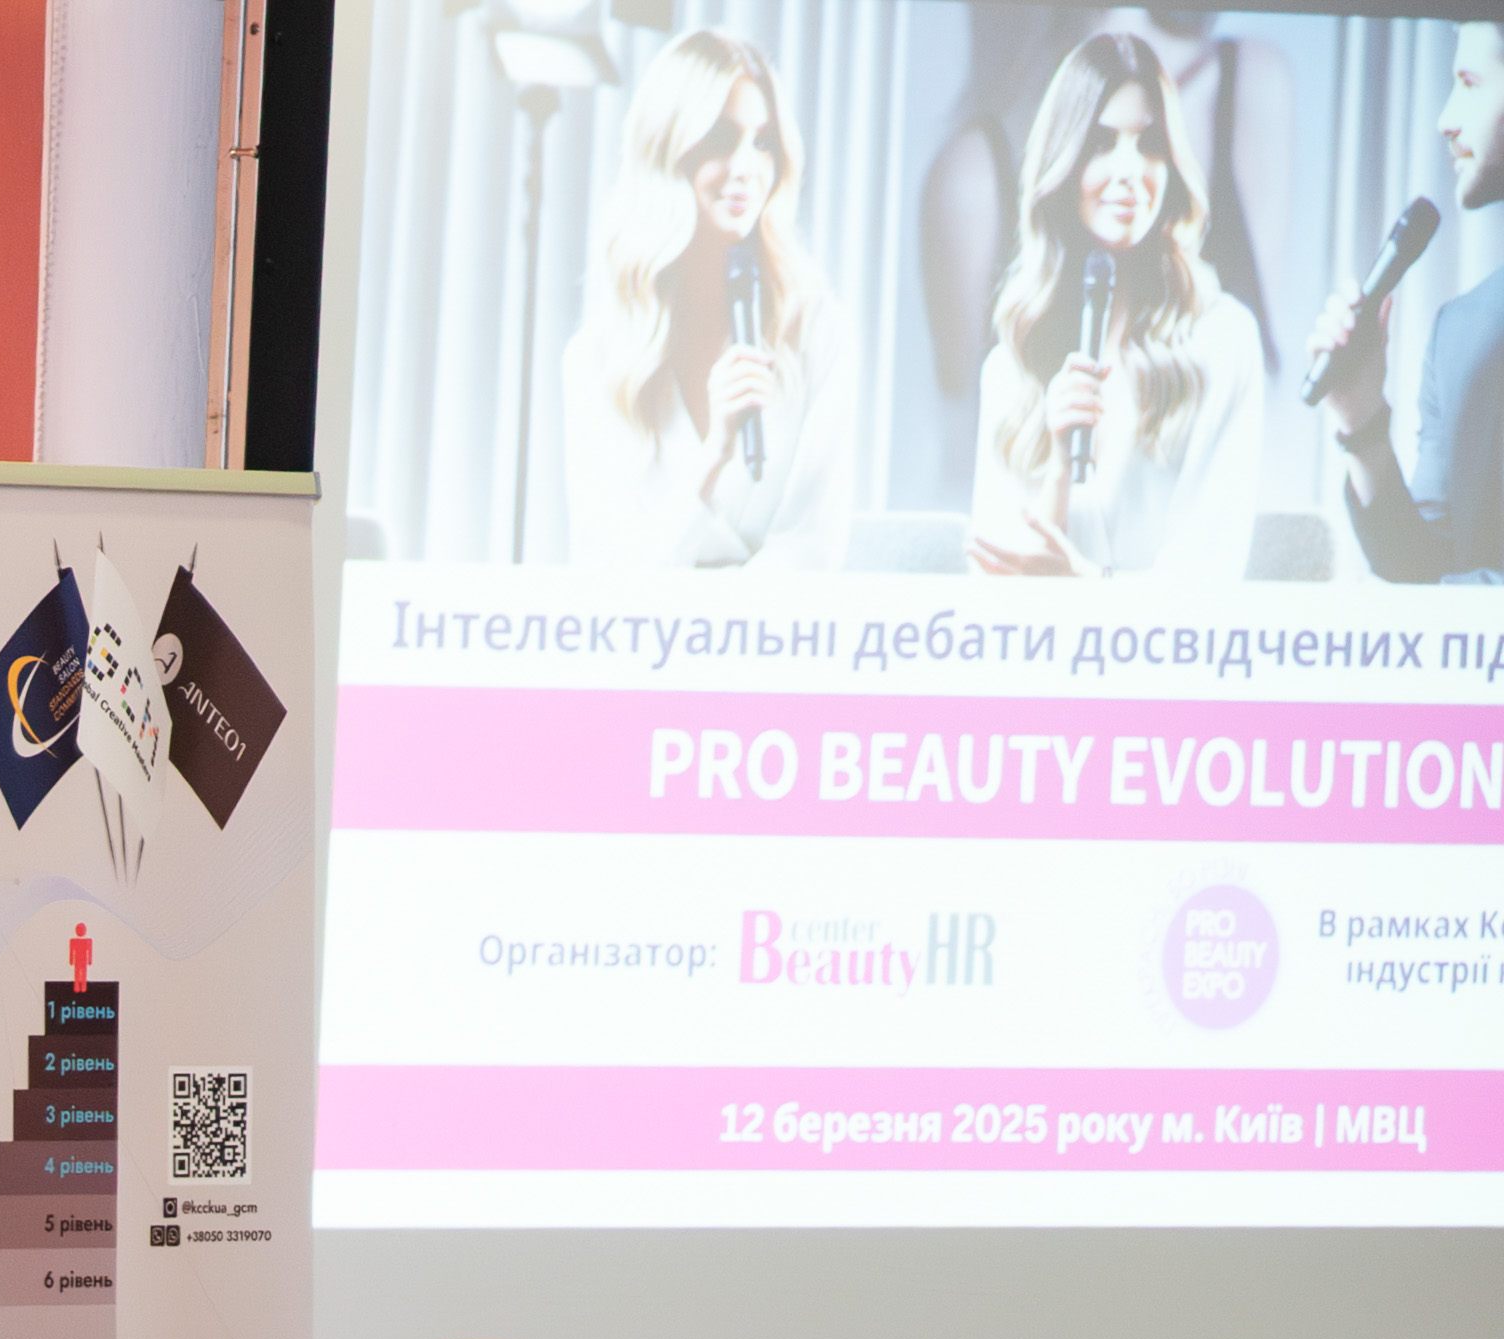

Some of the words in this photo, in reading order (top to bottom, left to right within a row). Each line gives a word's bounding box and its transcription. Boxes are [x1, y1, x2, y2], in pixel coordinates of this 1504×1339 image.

[391, 601, 838, 669] Інтелектуальні
[854, 609, 1057, 671] дебати
[1072, 623, 1424, 679] досвідчених
[649, 729, 798, 801] PRO
[819, 732, 1093, 804] BEAUTY
[1110, 735, 1503, 811] EVOLUTION
[1184, 909, 1236, 938] PRO
[1319, 909, 1336, 938] В
[1348, 914, 1469, 947] рамках
[479, 935, 718, 977] Організатор:
[1183, 940, 1268, 969] BEAUTY
[1348, 954, 1491, 993] індустрії
[48, 1002, 55, 1019] 1
[61, 1001, 115, 1024] рівень
[45, 1053, 56, 1071] 2
[61, 1053, 115, 1076] рівень
[45, 1105, 55, 1123] 3
[60, 1105, 114, 1128] рівень
[719, 1104, 764, 1143] 12
[773, 1102, 941, 1154] березня
[951, 1104, 1047, 1143] 2025
[1057, 1110, 1152, 1154] року
[1161, 1110, 1204, 1143] м.
[1215, 1104, 1304, 1144] Київ
[1336, 1104, 1427, 1153] МВЦ
[44, 1157, 55, 1174] 4
[60, 1156, 114, 1178] рівень
[44, 1215, 55, 1232] 5
[60, 1214, 113, 1237] рівень
[44, 1271, 54, 1289] 6
[60, 1270, 113, 1292] рівень
